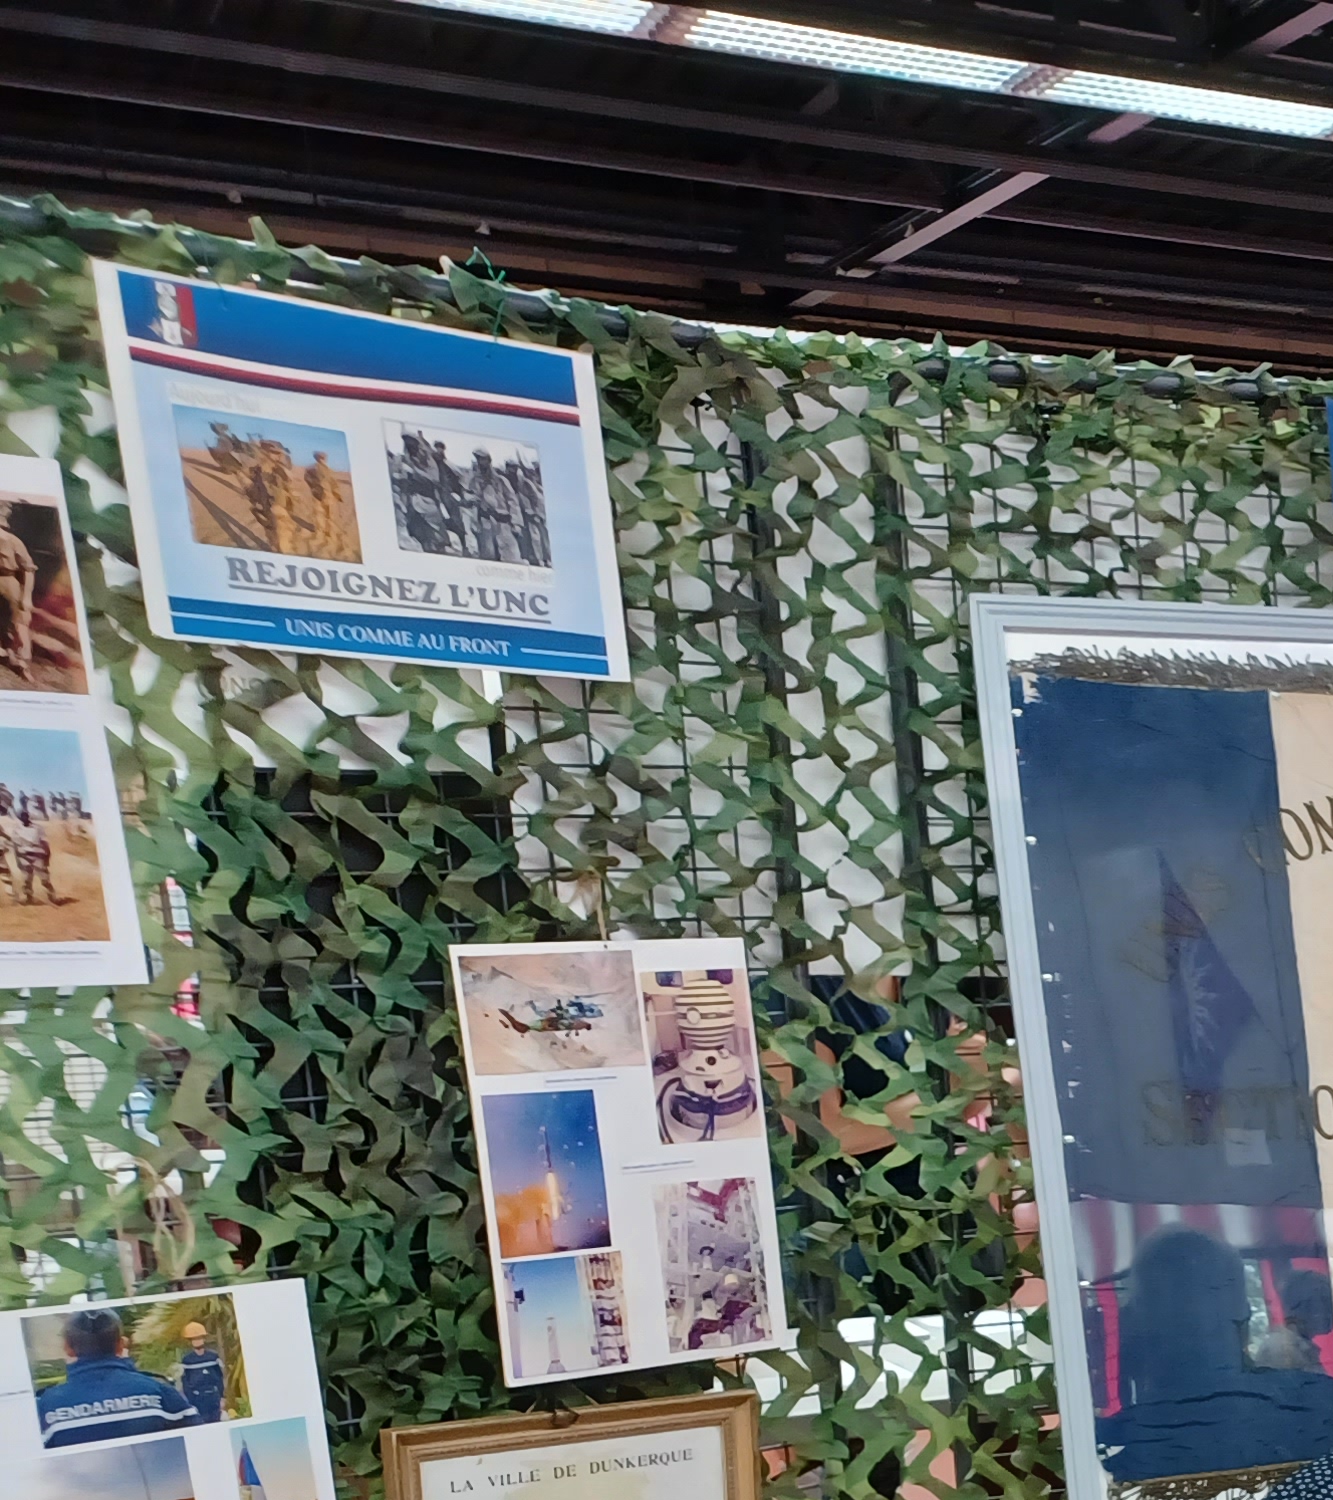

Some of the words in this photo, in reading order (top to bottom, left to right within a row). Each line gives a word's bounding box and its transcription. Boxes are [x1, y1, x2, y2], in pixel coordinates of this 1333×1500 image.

[224, 556, 441, 604] REJOIGNEZ
[447, 583, 550, 616] L'UNC
[283, 617, 335, 640] UNIS
[337, 623, 414, 648] COMME
[416, 631, 445, 651] AU
[448, 635, 512, 657] FRONT
[44, 1393, 163, 1425] GENDARMERIE
[449, 1478, 475, 1494] LA
[487, 1468, 542, 1488] VILLE
[552, 1464, 578, 1480] DE
[588, 1448, 694, 1476] DUNKERQUE
